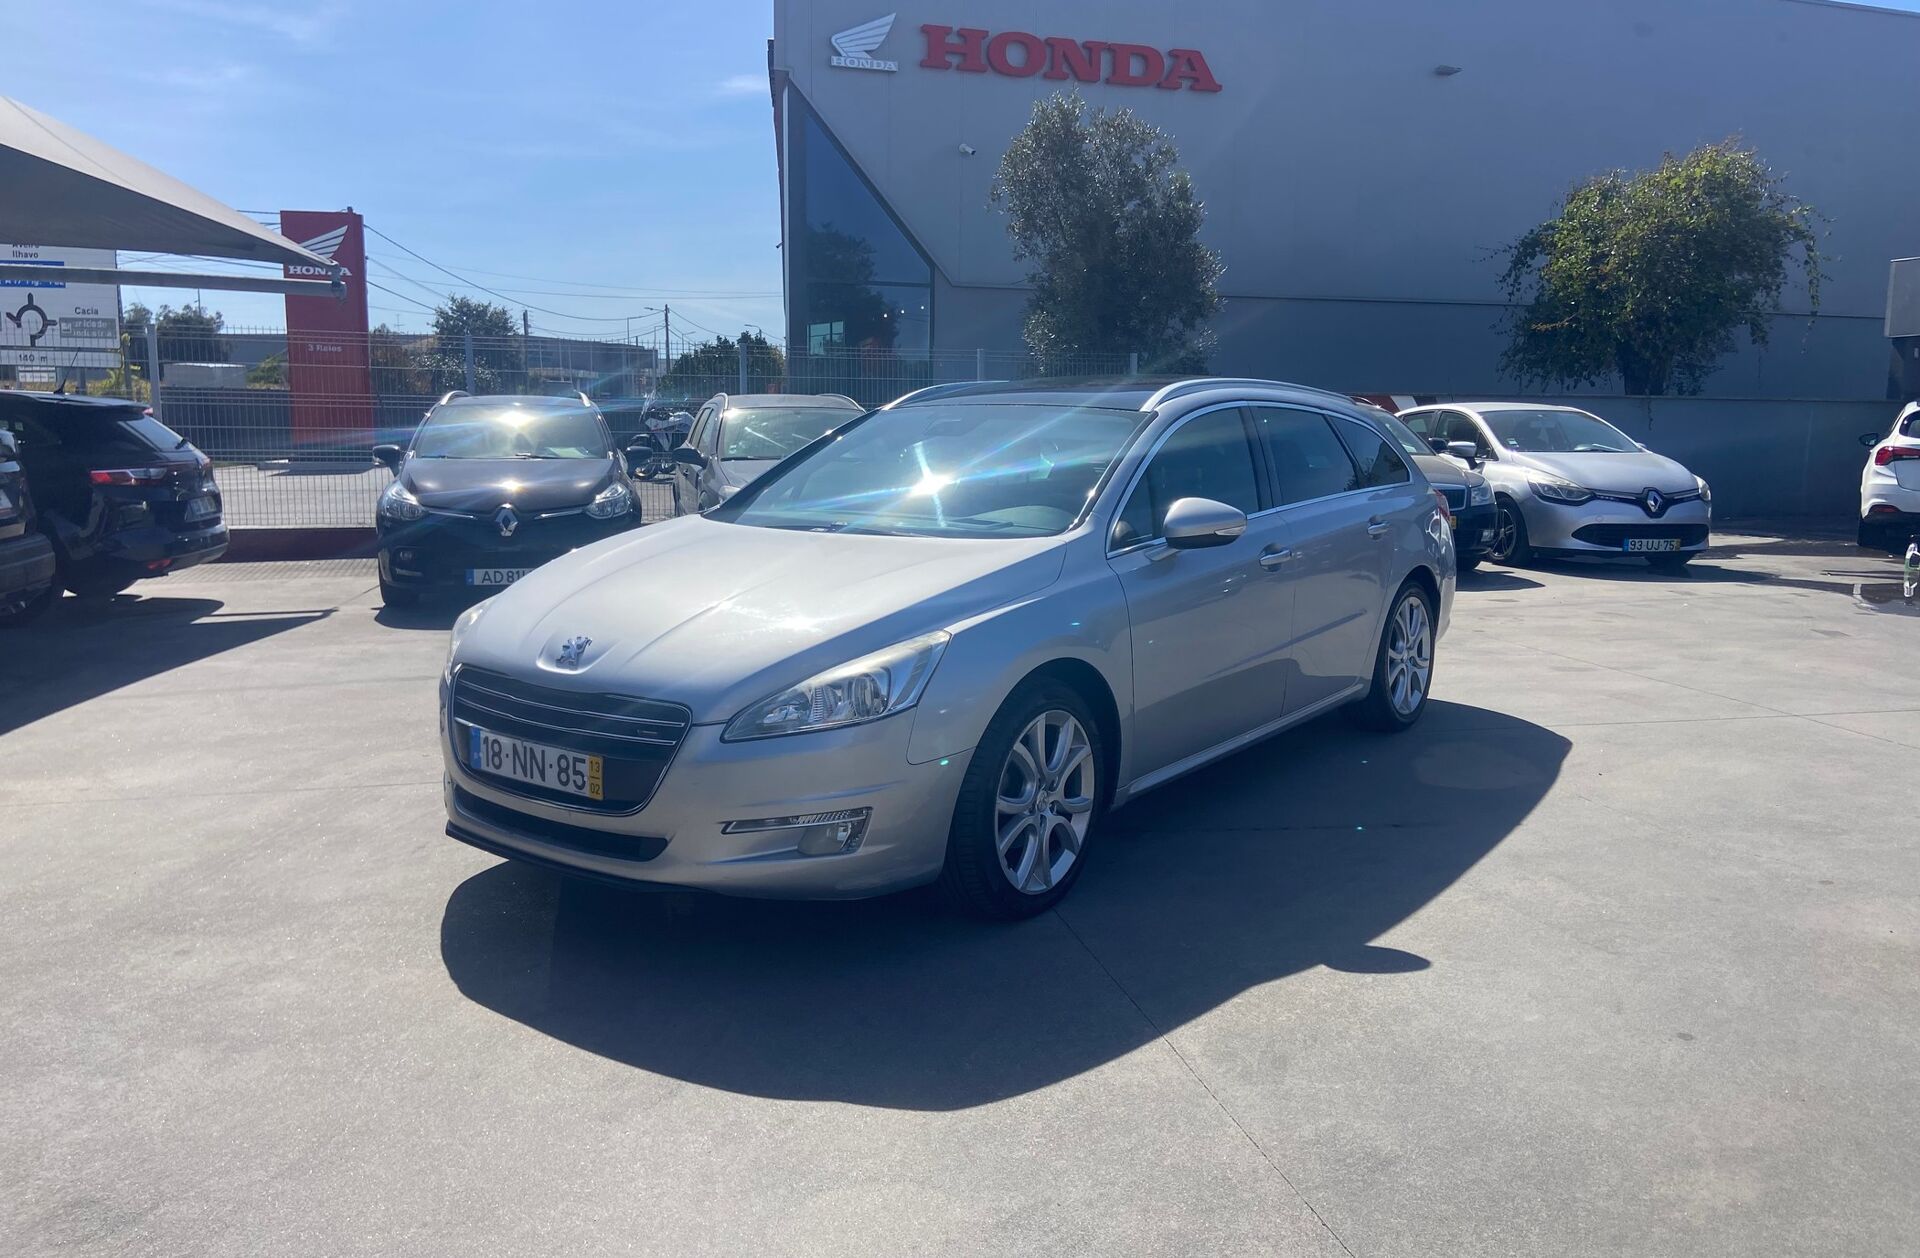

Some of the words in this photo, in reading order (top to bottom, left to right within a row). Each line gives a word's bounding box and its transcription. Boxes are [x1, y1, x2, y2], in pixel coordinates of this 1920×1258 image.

[830, 56, 898, 71] HONDA
[920, 24, 1222, 92] HONDA
[288, 265, 352, 276] HONA
[74, 306, 99, 315] Cacia
[481, 570, 504, 584] AD
[590, 760, 600, 773] 13
[590, 782, 601, 796] 02
